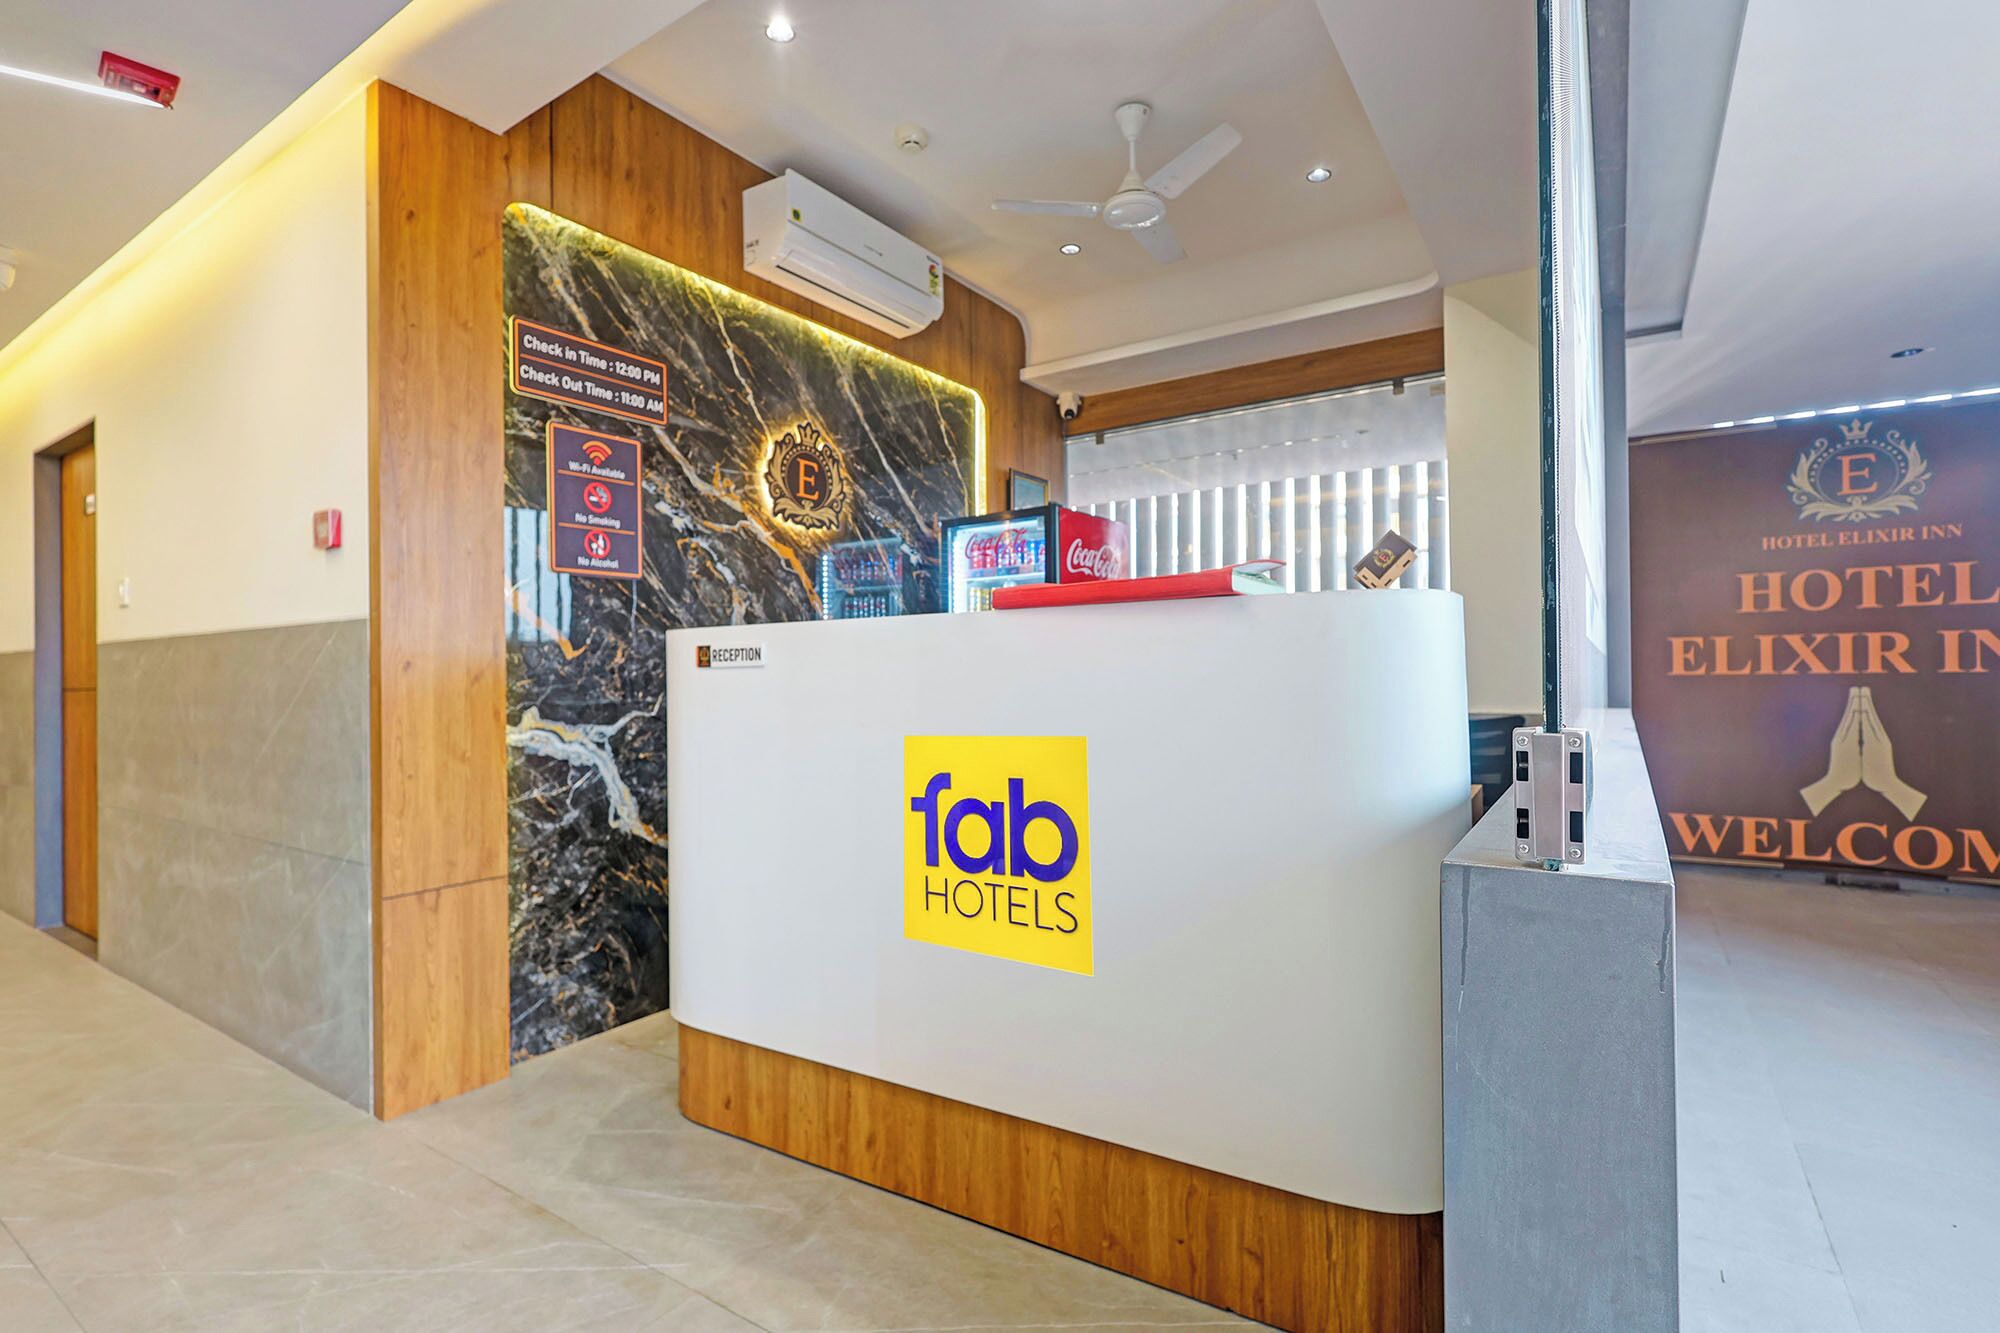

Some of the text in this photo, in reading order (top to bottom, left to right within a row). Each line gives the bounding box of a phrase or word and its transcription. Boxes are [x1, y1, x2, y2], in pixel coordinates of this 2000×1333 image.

[523, 334, 563, 358] Check
[565, 346, 577, 361] in
[578, 349, 607, 370] Time
[615, 361, 642, 380] 12:00
[643, 369, 661, 386] PM
[519, 364, 560, 387] Check
[562, 375, 583, 393] Out
[584, 381, 613, 401] Time
[621, 391, 645, 409] 11:00
[646, 398, 664, 414] AM
[568, 460, 625, 480] Wi-Fi Available
[796, 458, 819, 501] E
[1836, 452, 1879, 496] E
[575, 512, 621, 529] No Smoking
[1762, 523, 1964, 550] HOTEL ELIXIR INN
[577, 556, 619, 569] No Alcohol
[1736, 560, 2000, 614] HOTEL
[712, 647, 761, 662] RECEPTION
[1667, 631, 1918, 676] ELIXIR
[911, 772, 1079, 883] fab
[925, 875, 1078, 934] HOTELS
